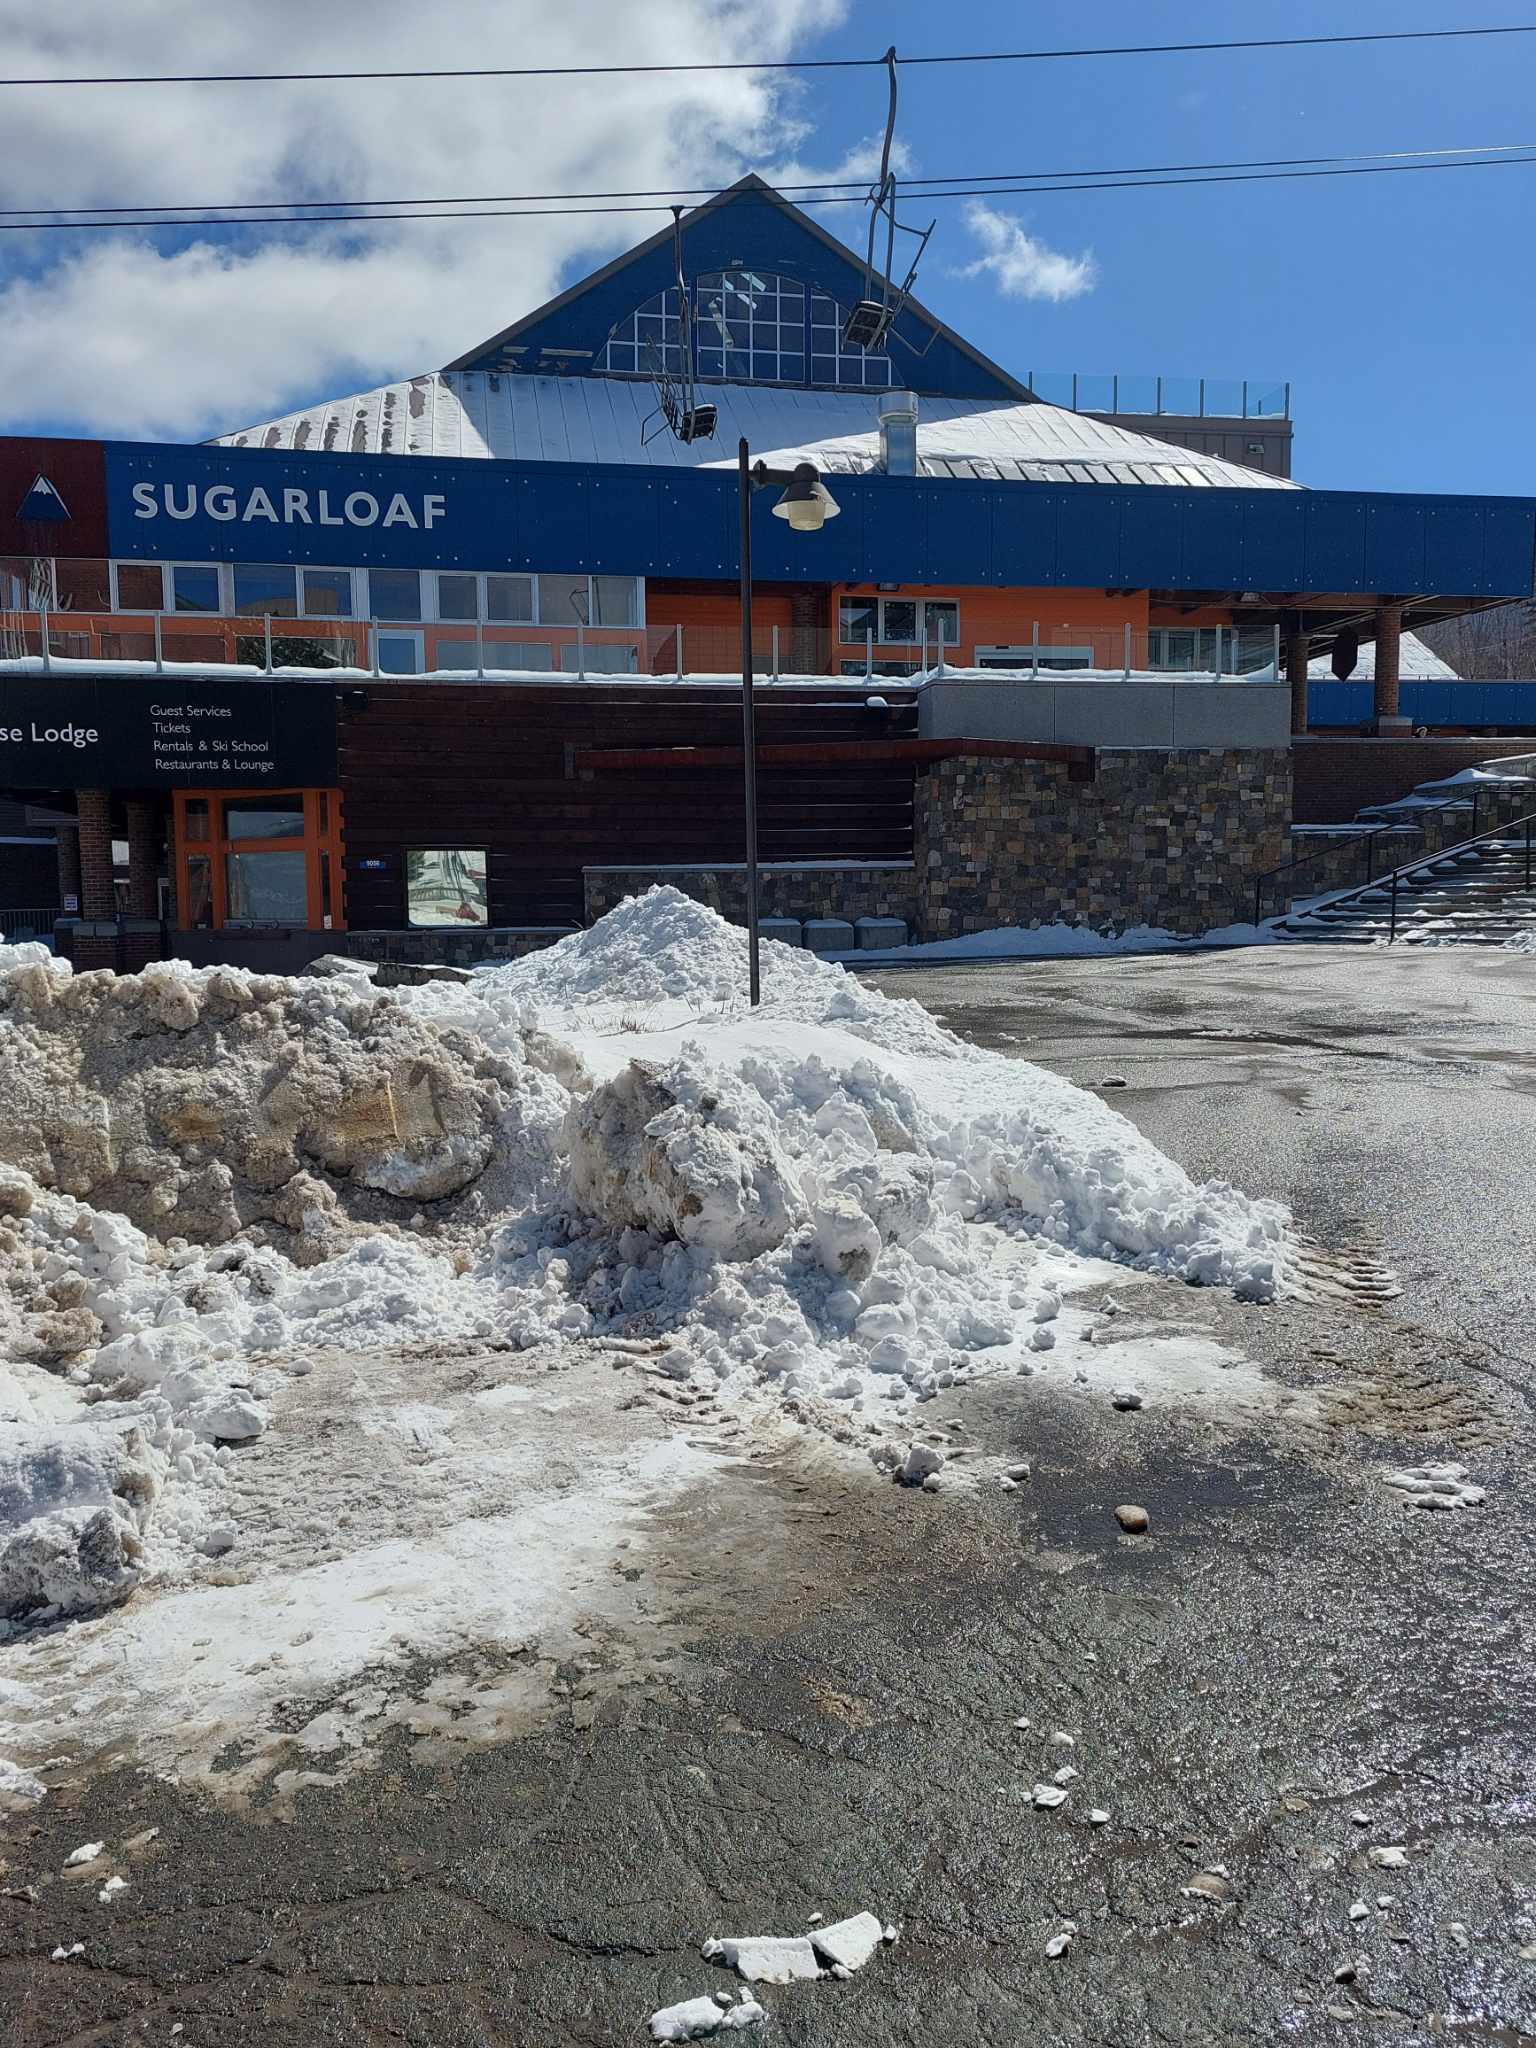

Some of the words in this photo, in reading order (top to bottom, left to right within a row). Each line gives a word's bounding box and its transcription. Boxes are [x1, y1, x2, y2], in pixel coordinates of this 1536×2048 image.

[132, 483, 446, 529] SUGARLOAF
[150, 705, 184, 716] Guest
[187, 705, 232, 717] Services
[152, 722, 191, 733] Tickets
[31, 723, 99, 747] Lodge
[154, 740, 193, 751] Rentals
[198, 740, 208, 751] &
[212, 740, 228, 751] Ski
[231, 740, 269, 751] School
[155, 759, 219, 770] Restaurants
[222, 759, 231, 770] &
[234, 759, 275, 773] Lounge
